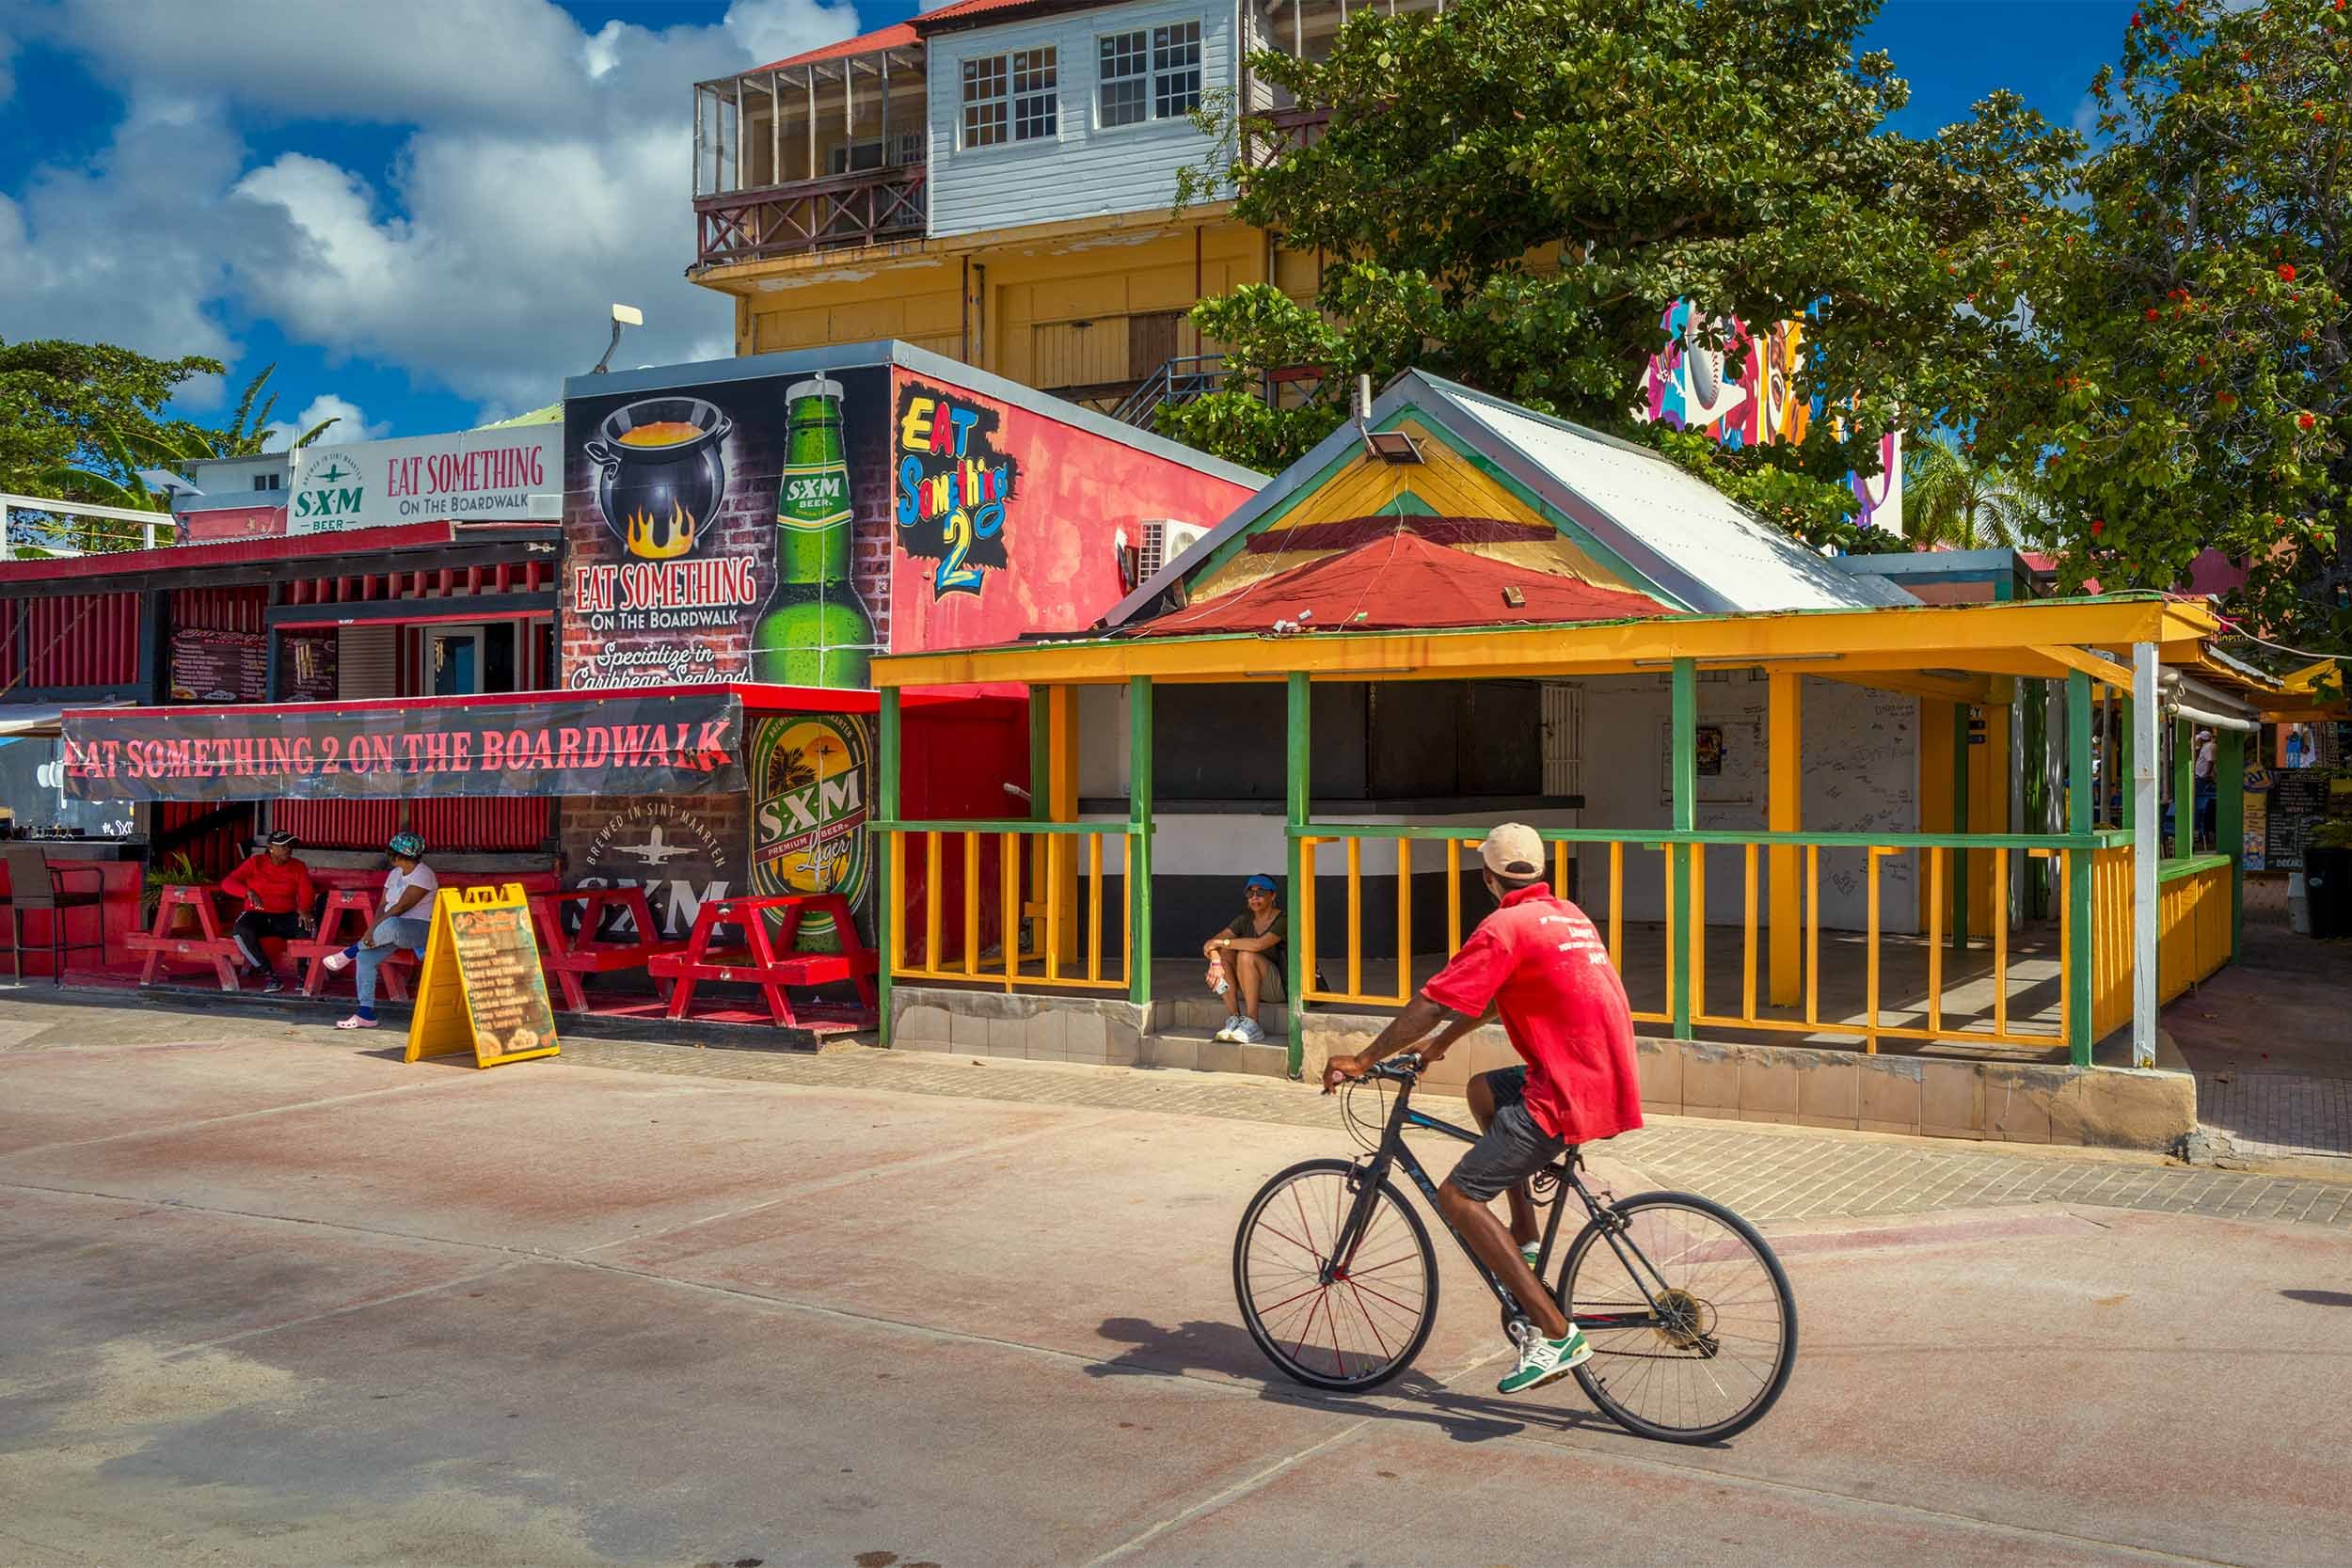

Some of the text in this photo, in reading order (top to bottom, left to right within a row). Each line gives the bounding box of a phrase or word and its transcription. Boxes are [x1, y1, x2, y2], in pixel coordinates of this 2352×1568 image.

[900, 397, 979, 458] EAT
[387, 446, 543, 498] EAT SOMETHING
[313, 519, 343, 531] BEER
[399, 494, 528, 515] ON THE BOARDWALK
[937, 507, 984, 594] 2
[576, 557, 755, 611] EAT SOMETHING
[591, 610, 739, 630] ON THE BOARDWALK
[571, 667, 660, 690] Caribbean
[597, 642, 715, 673] Specialize in
[65, 721, 733, 779] EAT SOMETHING 2 ON THE BOARDWALK
[586, 801, 727, 868] BREWED IN SINT MAARTEN
[768, 823, 844, 857] PREMIUM BEER
